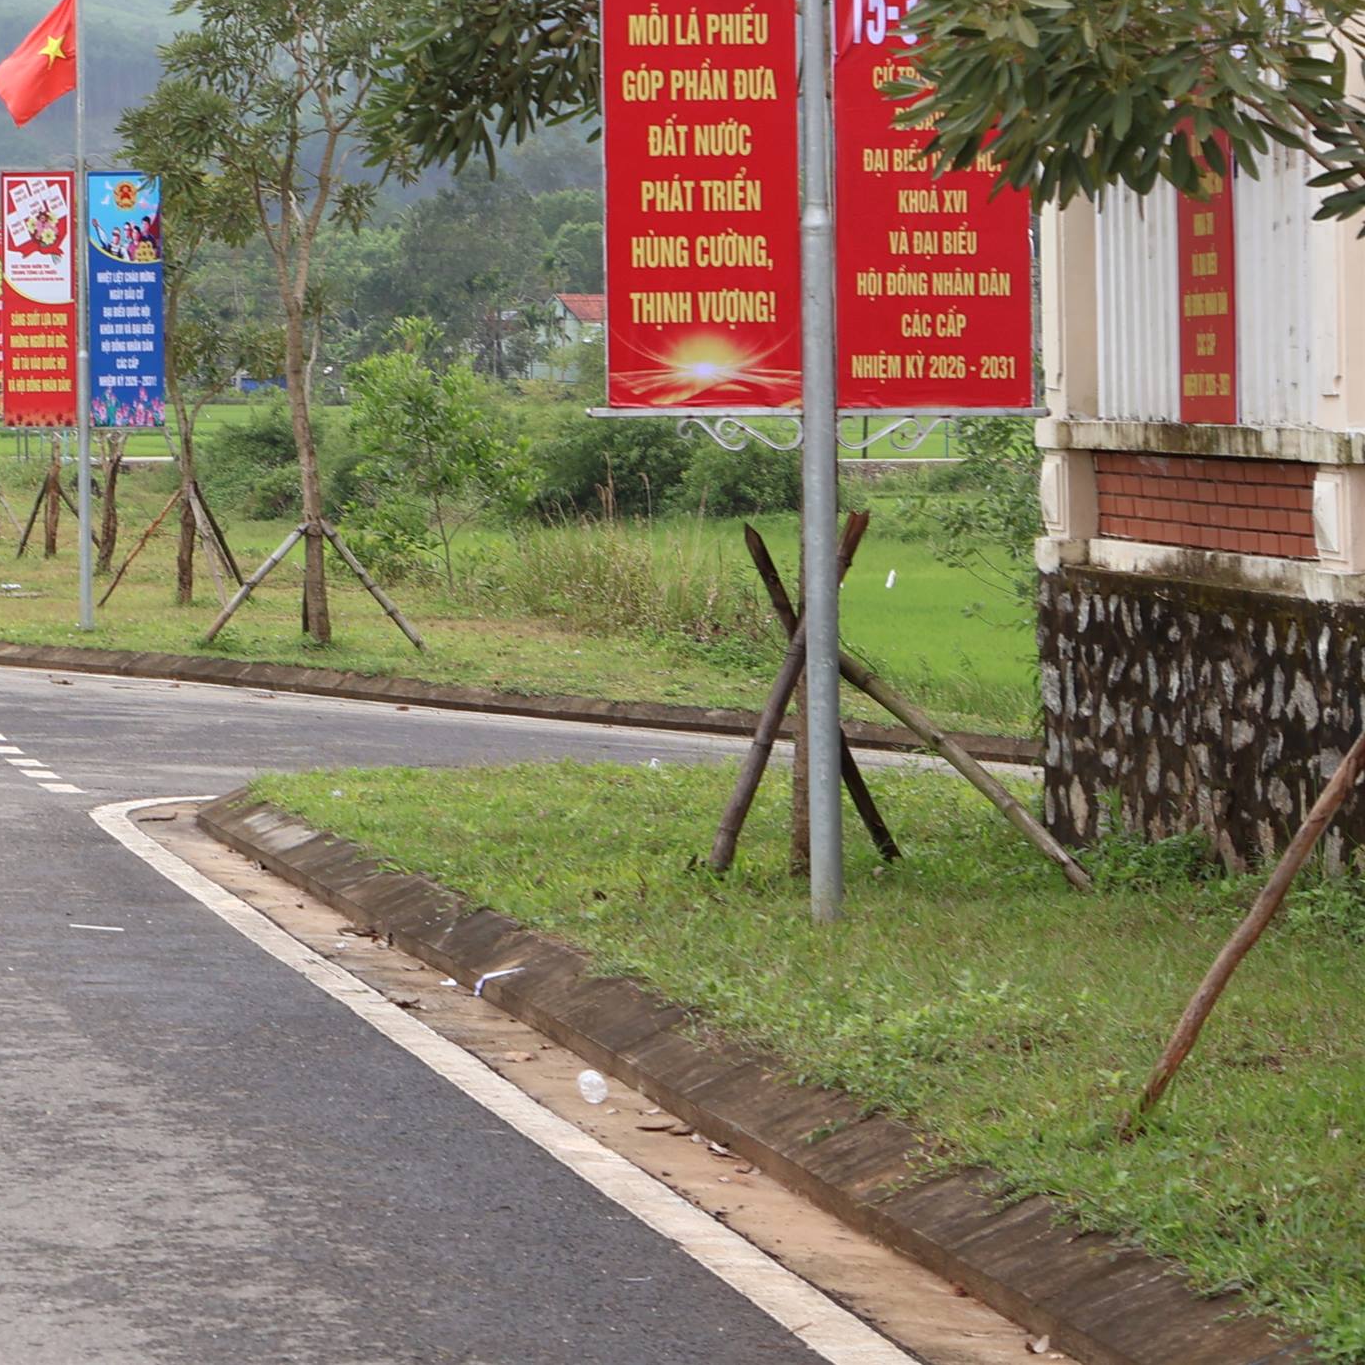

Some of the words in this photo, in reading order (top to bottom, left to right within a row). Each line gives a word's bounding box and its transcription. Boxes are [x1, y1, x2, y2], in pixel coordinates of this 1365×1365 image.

[628, 3, 668, 45] MỖI
[675, 7, 701, 45] LÁ
[707, 3, 768, 45] PHIẾU
[622, 63, 664, 101] GÓP
[671, 58, 728, 100] PHẦN
[734, 66, 777, 100] ĐƯA
[648, 113, 688, 156] ĐẤT
[695, 118, 751, 156] NƯỚC
[864, 149, 888, 177] ĐẠI
[641, 174, 695, 212] PHÁT
[700, 167, 761, 211] TRIỂN
[898, 185, 939, 213] KHOÁ
[943, 190, 967, 213] XVI
[632, 229, 689, 268] HÙNG
[696, 227, 773, 271] CƯỜNG,
[889, 226, 909, 255] VÀ
[913, 231, 938, 260] ĐẠI
[943, 221, 977, 255] BIỂU
[857, 267, 882, 301] HỘI
[886, 264, 928, 296] ĐỒNG
[932, 267, 975, 296] NHÂN
[979, 267, 1011, 296] DÂN
[630, 292, 692, 330] THỊNH
[698, 288, 776, 330] VƯỢNG!
[901, 308, 932, 337] CÁC
[936, 305, 966, 337] CẤP
[851, 350, 901, 384] NHIỆM
[906, 350, 925, 378] KỲ
[929, 356, 966, 379] 2026
[980, 356, 1015, 379] 2031
